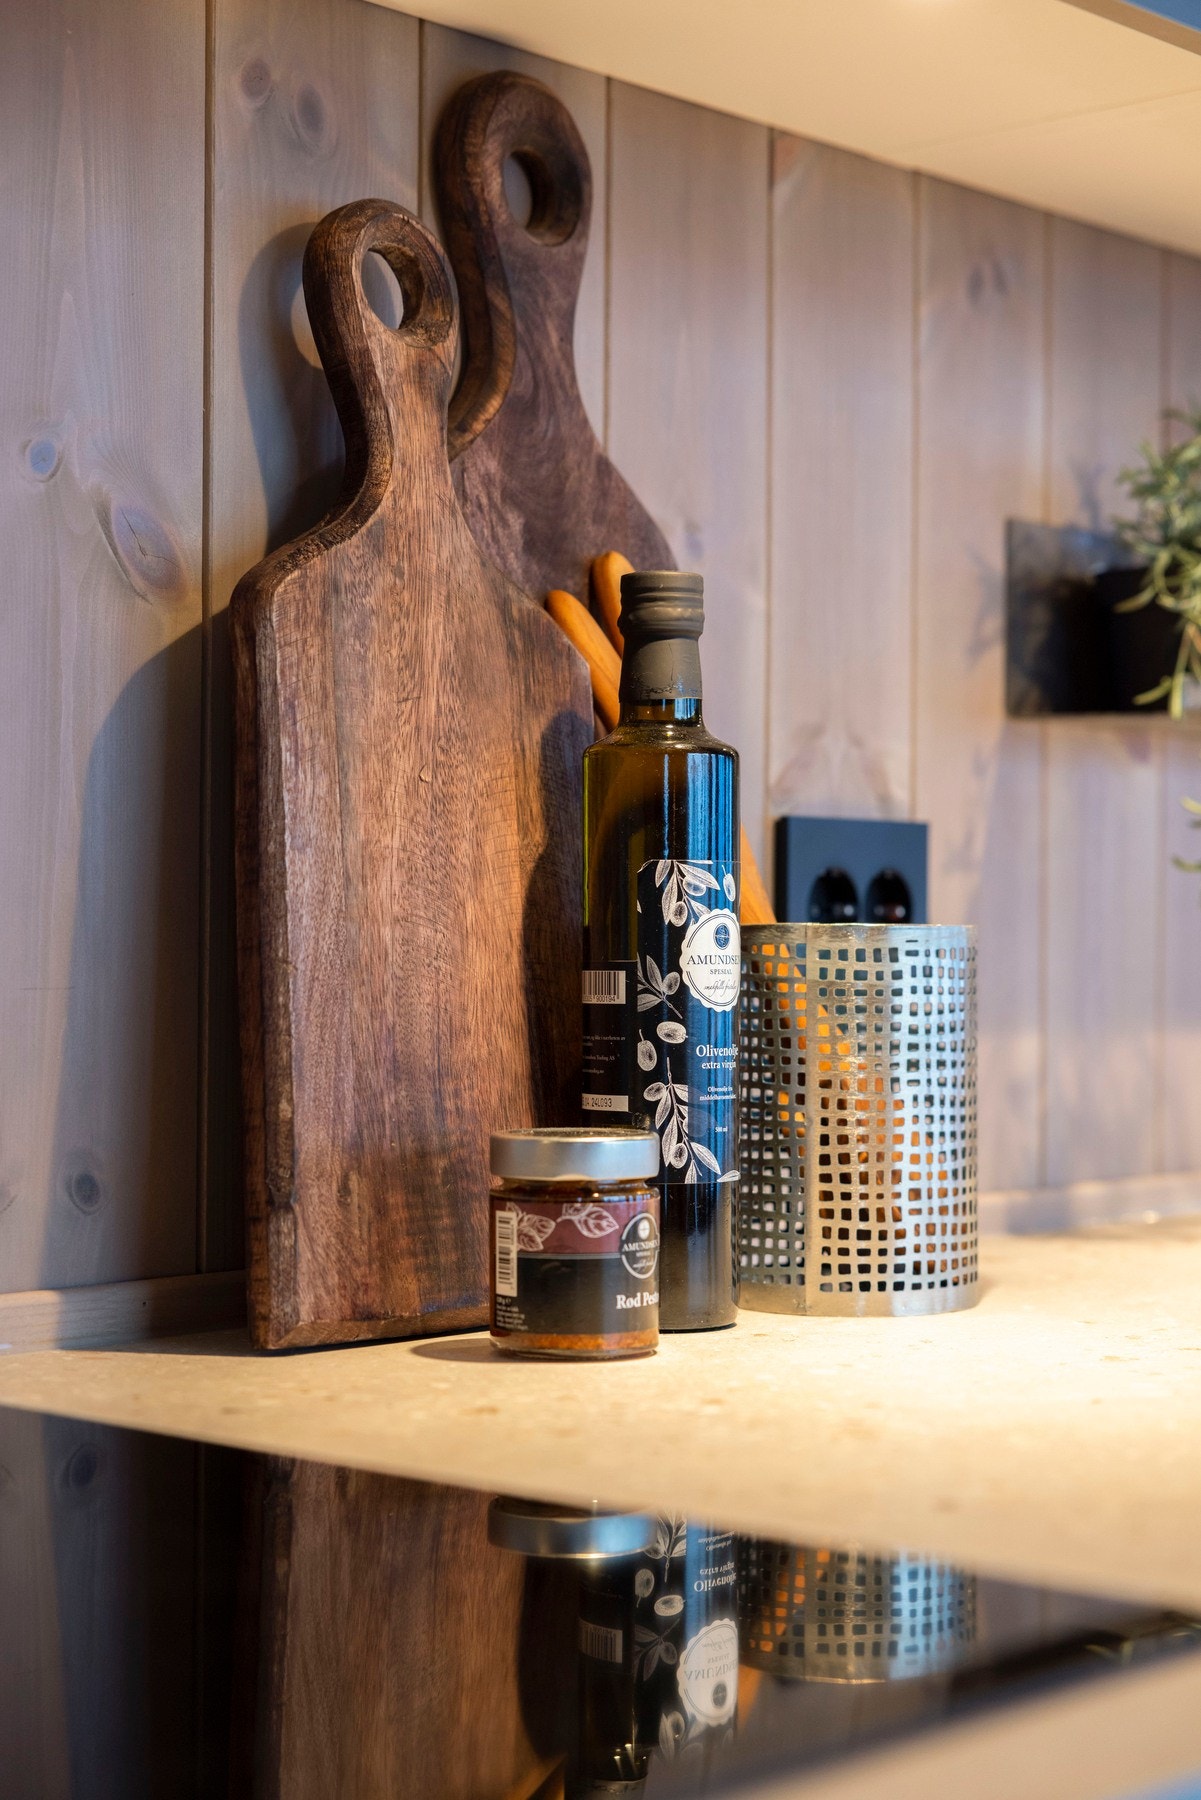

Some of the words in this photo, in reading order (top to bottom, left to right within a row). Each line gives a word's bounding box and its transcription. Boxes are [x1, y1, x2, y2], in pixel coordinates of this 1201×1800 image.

[696, 1043, 739, 1059] Olivenolje
[701, 1061, 720, 1069] extra
[721, 1060, 736, 1070] virgin
